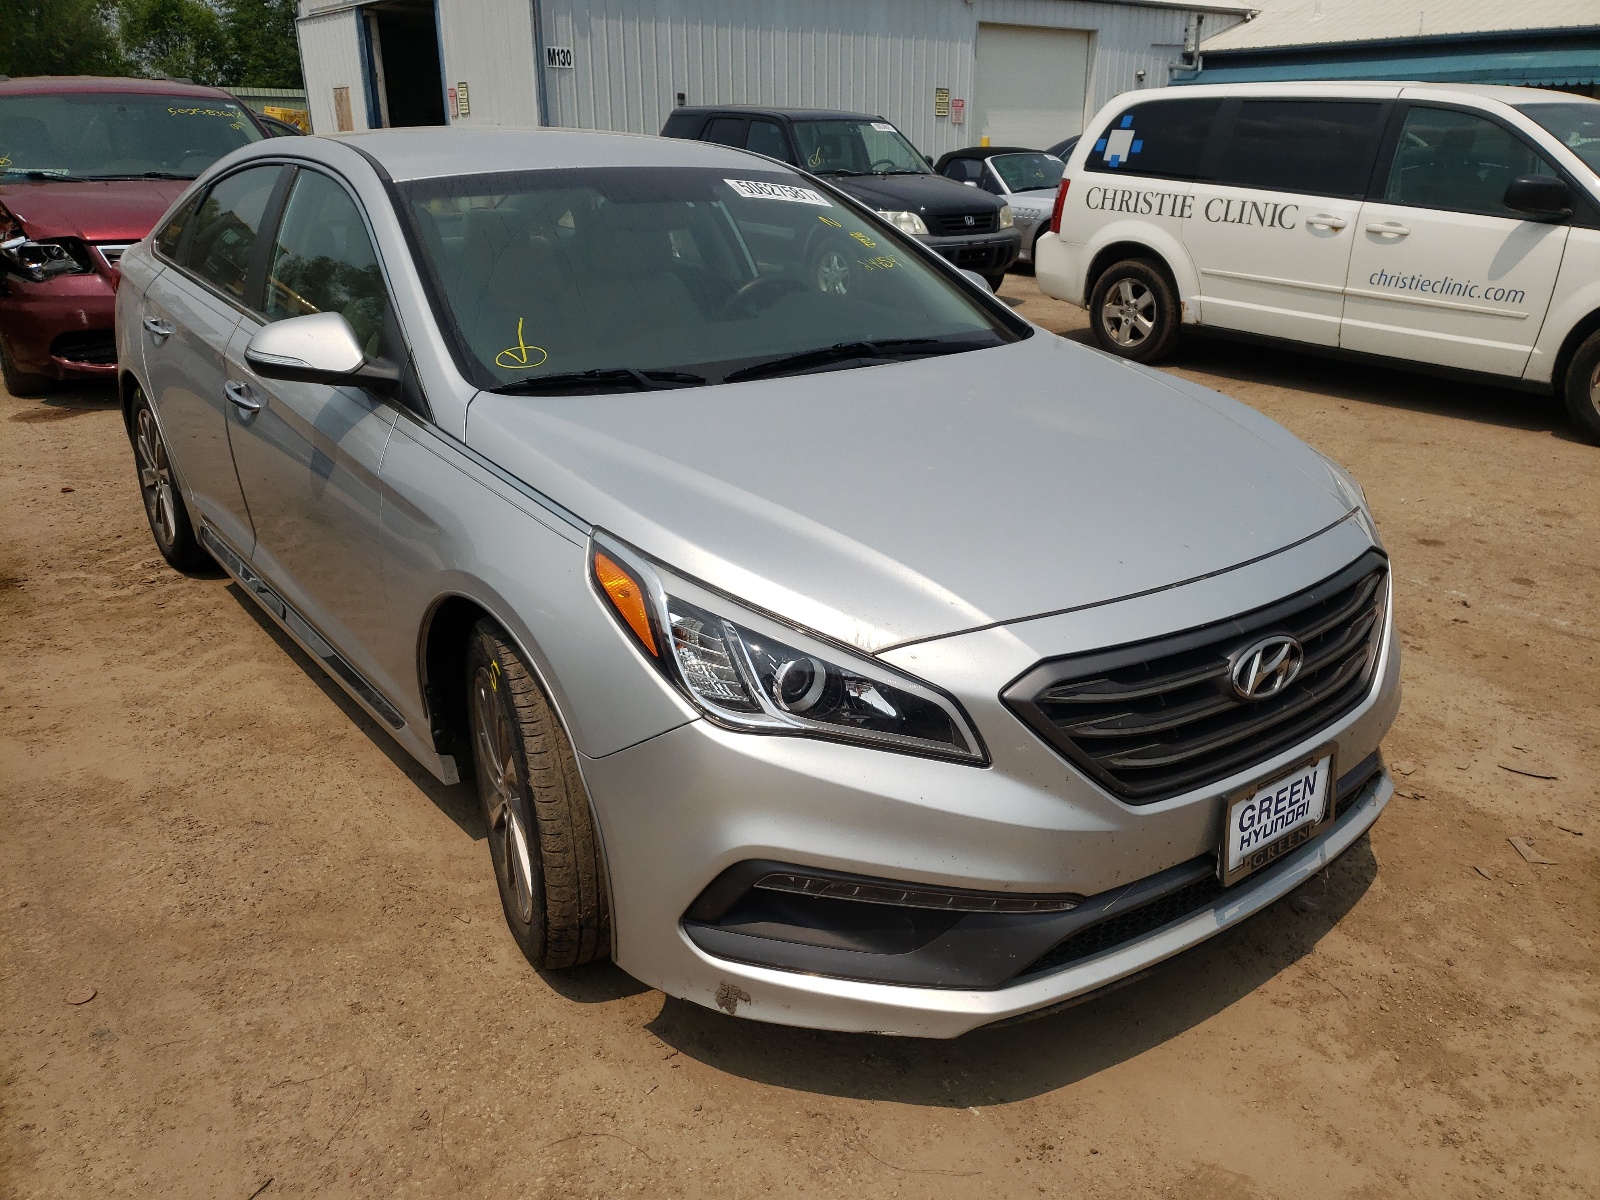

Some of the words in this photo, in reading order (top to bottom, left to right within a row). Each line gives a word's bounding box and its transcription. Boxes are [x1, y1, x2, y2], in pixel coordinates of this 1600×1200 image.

[547, 48, 572, 67] M130
[735, 181, 814, 201] 50627581
[1086, 186, 1196, 219] CHRISTIE
[1204, 197, 1299, 230] CLINIC
[1369, 268, 1525, 304] christieclinic.com
[1238, 770, 1318, 833] GREEN
[1240, 799, 1310, 851] HYUNDAI
[1253, 825, 1309, 864] GREEN
